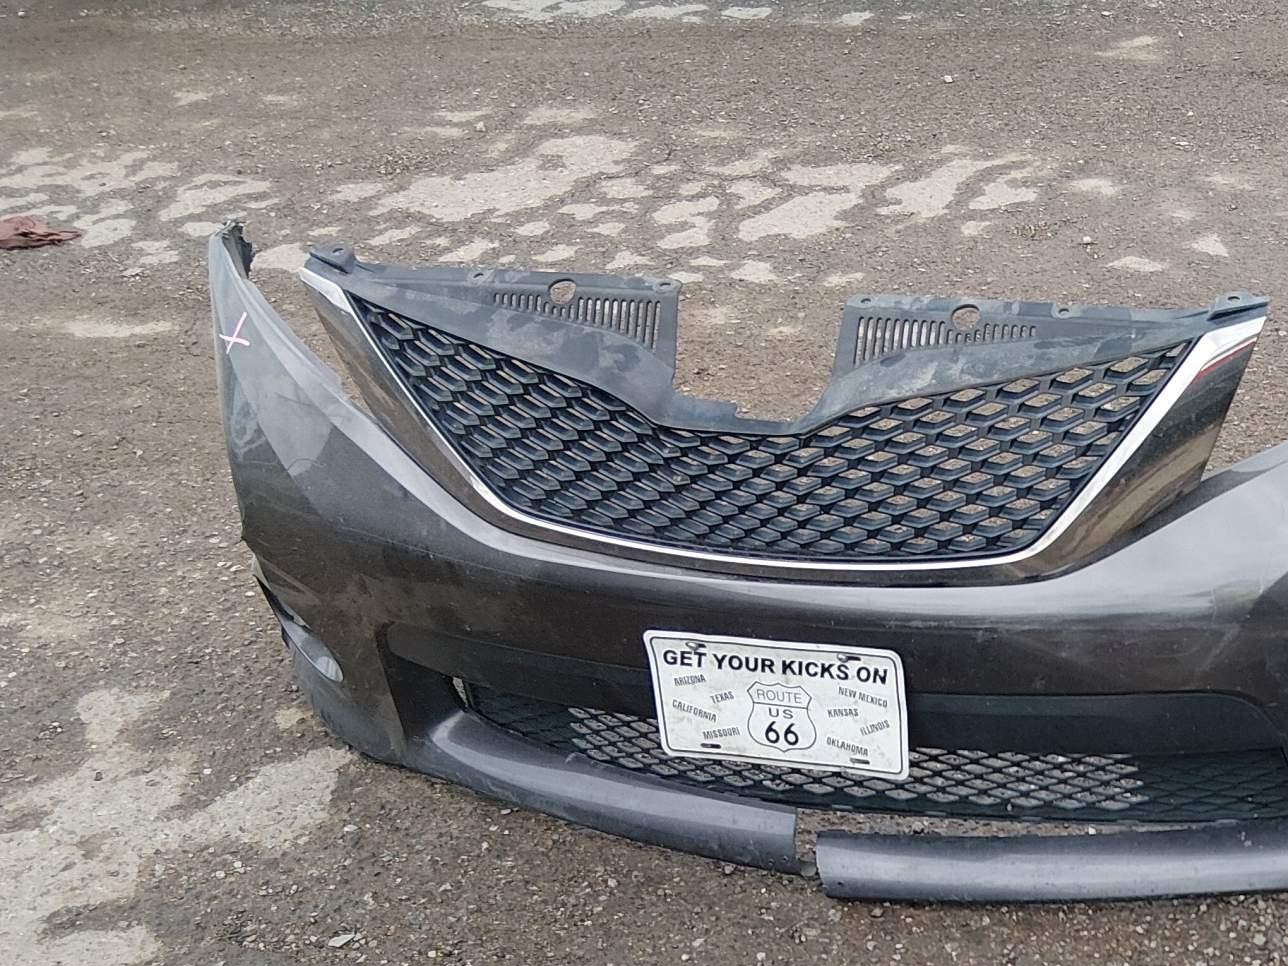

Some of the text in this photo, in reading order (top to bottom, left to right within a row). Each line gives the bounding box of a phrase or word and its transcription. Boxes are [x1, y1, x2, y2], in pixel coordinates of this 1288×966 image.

[663, 649, 888, 685] GET YOUR KICKS ON
[673, 674, 707, 686] ARIZONA
[710, 691, 735, 704] TEXAS
[756, 688, 803, 704] ROUTE
[838, 686, 888, 708] NEW MEXICO
[672, 699, 717, 723] CALIFORNIA
[768, 706, 794, 720] US
[827, 708, 859, 718] KANSAS
[702, 727, 740, 740] MISSOURI
[765, 721, 799, 746] 66
[860, 719, 890, 736] ILLINOIS
[826, 736, 868, 756] OKLAHOMA
